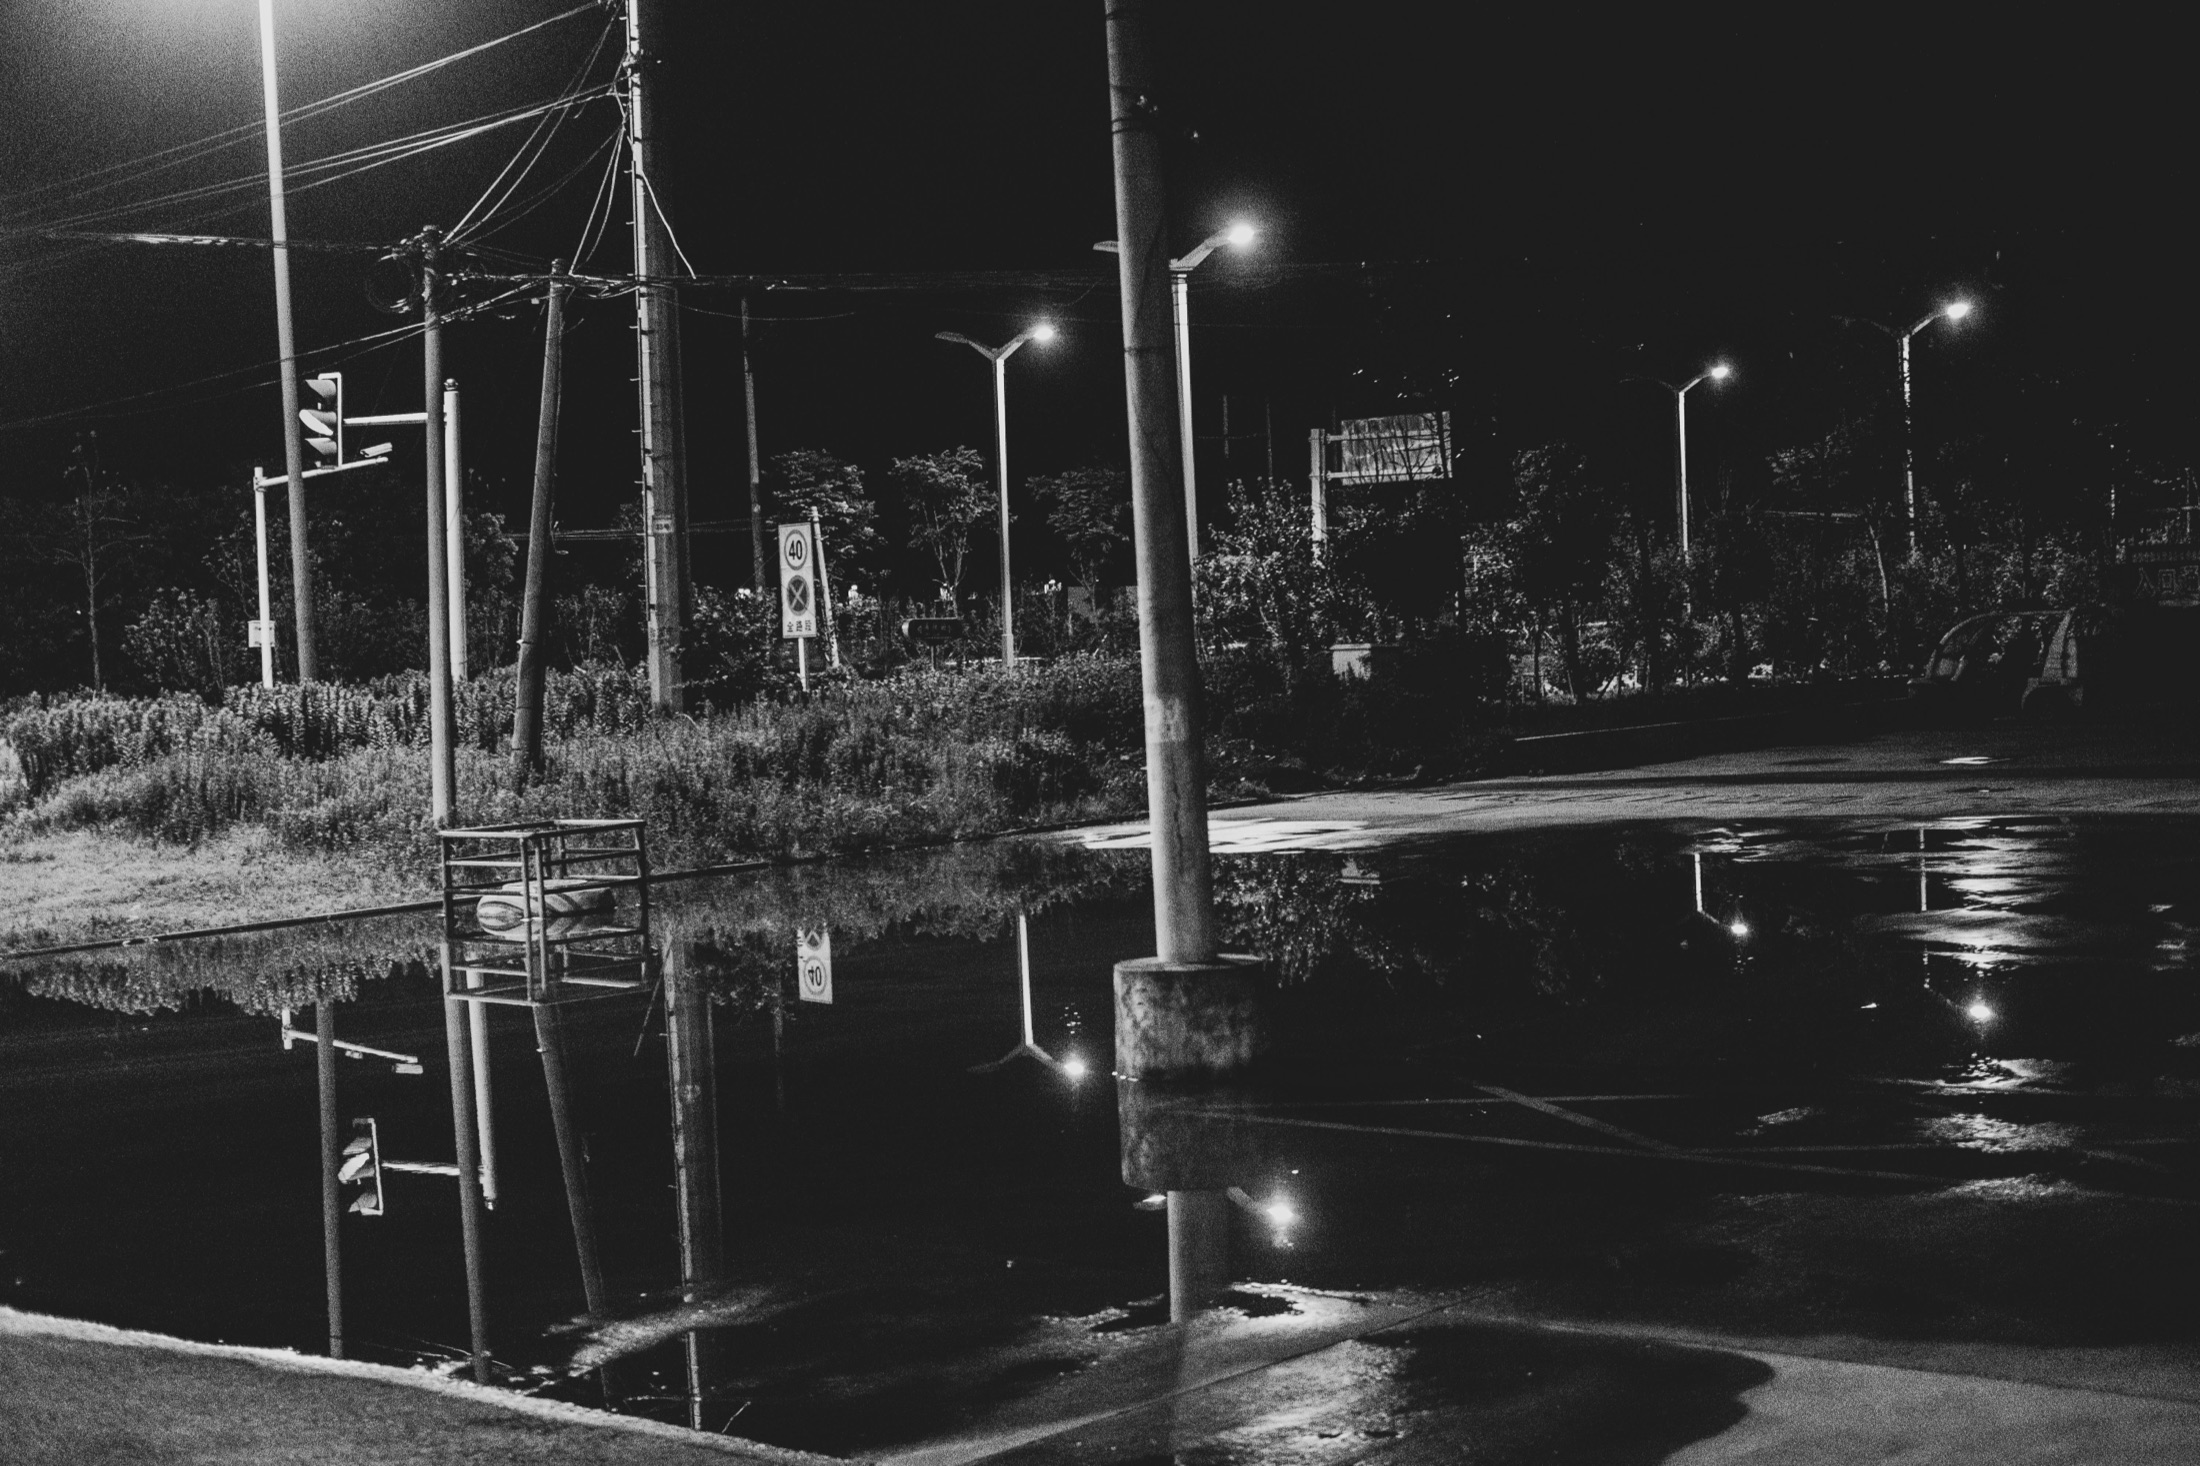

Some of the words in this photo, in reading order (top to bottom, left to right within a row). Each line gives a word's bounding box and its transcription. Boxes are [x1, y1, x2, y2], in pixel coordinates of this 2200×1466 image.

[789, 540, 803, 560] 40
[786, 619, 812, 632] 全路段
